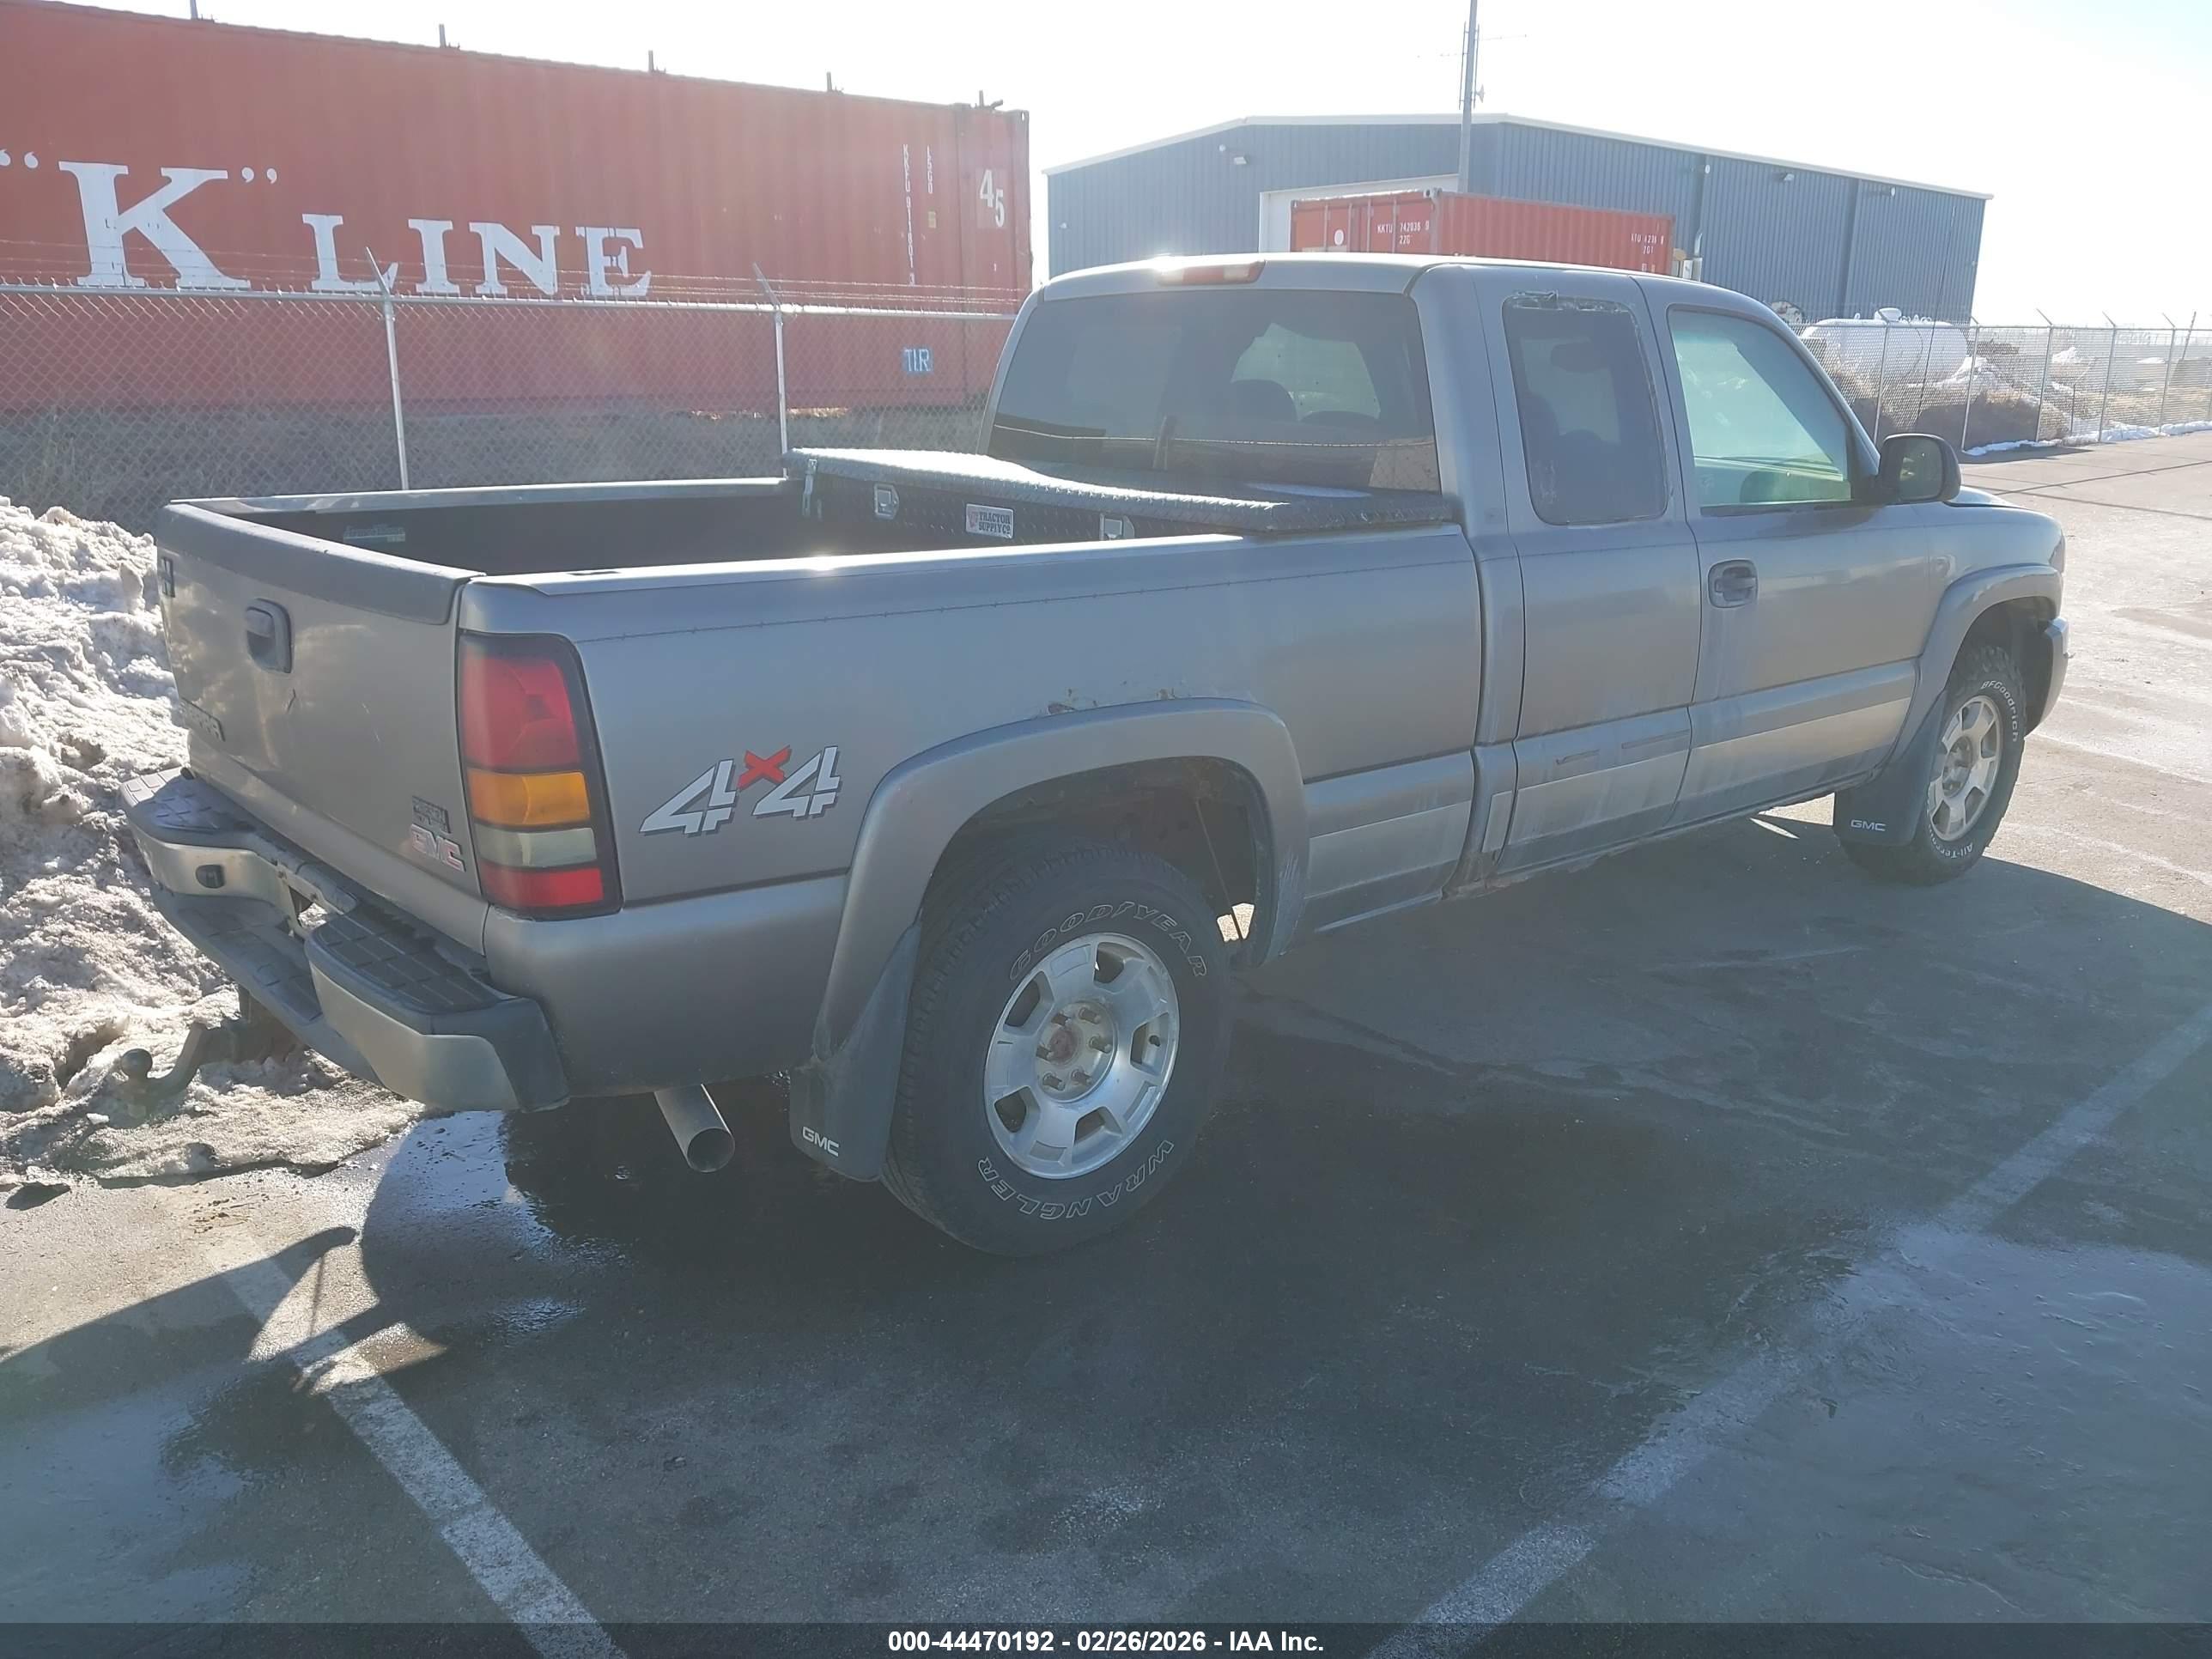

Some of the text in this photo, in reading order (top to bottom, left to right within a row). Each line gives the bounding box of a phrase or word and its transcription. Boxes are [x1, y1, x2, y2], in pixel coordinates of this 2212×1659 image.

[979, 168, 1006, 228] 45
[301, 213, 652, 296] LINE
[979, 512, 1012, 525] TRACTOR
[1980, 680, 2020, 742] BFGoodrich
[411, 823, 466, 873] GMC
[1850, 819, 1887, 832] GMC
[1009, 901, 1208, 981] GOODYEAR
[802, 1126, 840, 1157] GMC
[977, 1139, 1175, 1220] WRANGLER
